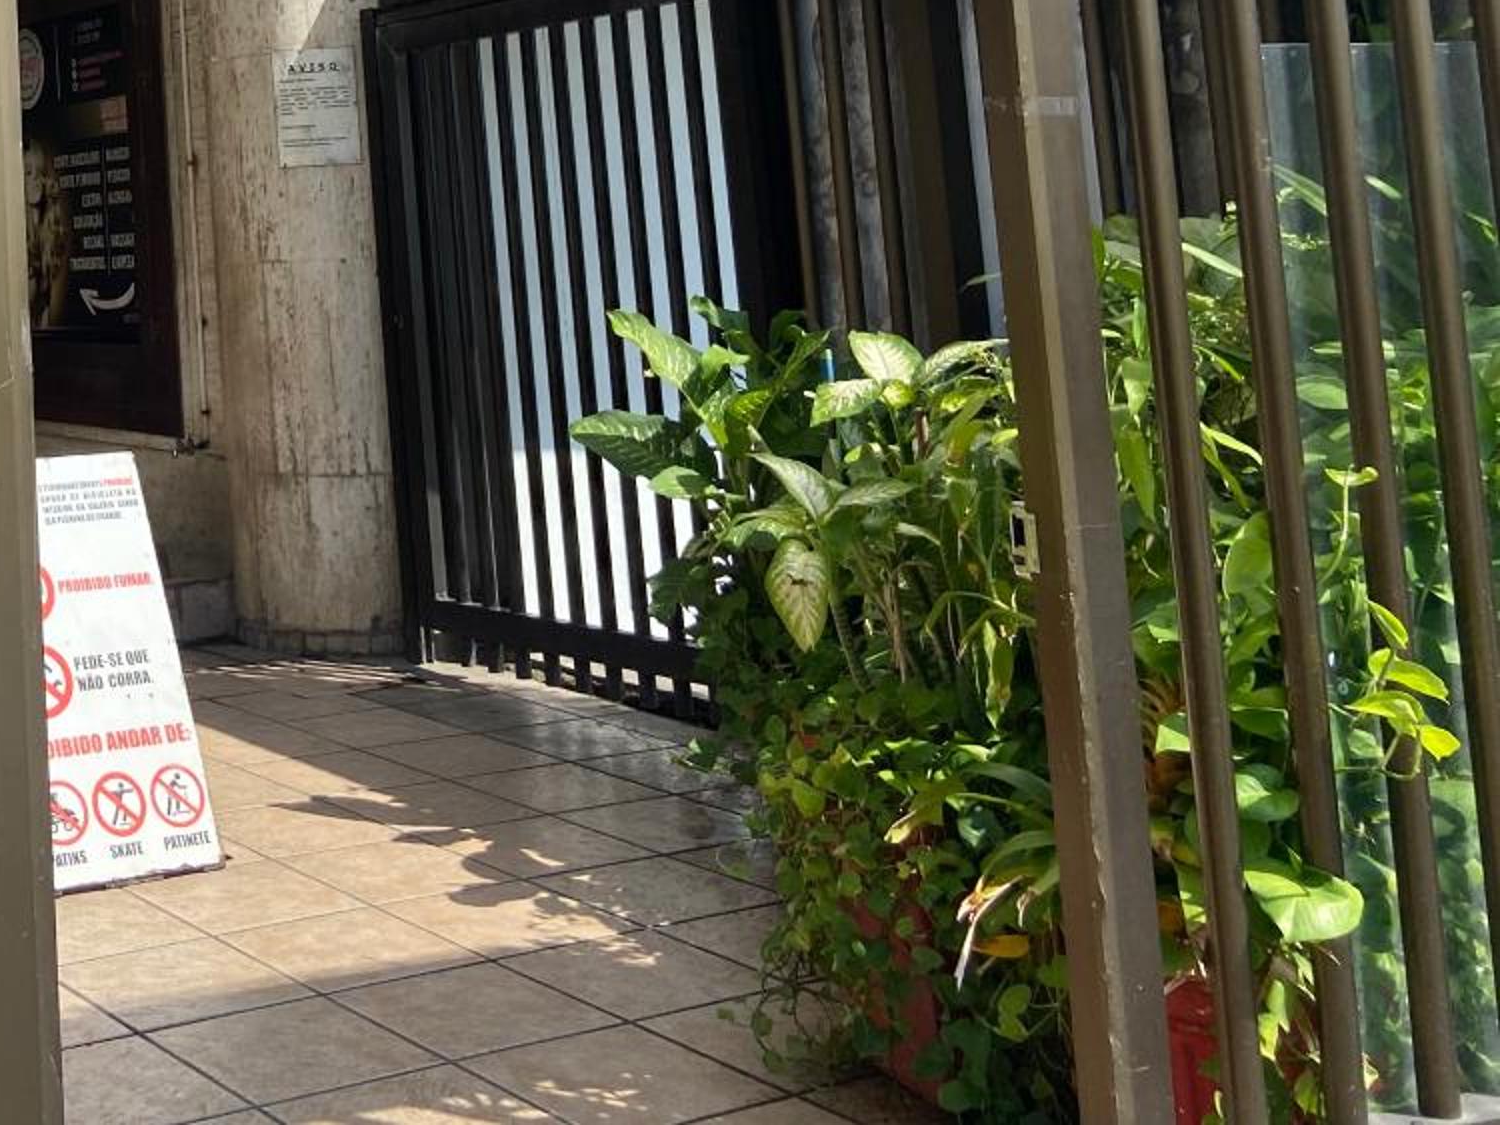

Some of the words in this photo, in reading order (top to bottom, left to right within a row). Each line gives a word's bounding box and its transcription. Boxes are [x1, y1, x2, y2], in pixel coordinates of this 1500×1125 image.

[57, 576, 111, 594] PROIBIDO
[74, 652, 124, 671] PEDE-SE
[125, 649, 150, 666] QUE
[77, 672, 104, 692] NÃO
[106, 725, 163, 751] ANDAR
[163, 722, 192, 744] DE:
[53, 850, 88, 868] ATINS
[109, 841, 144, 859] SKATE
